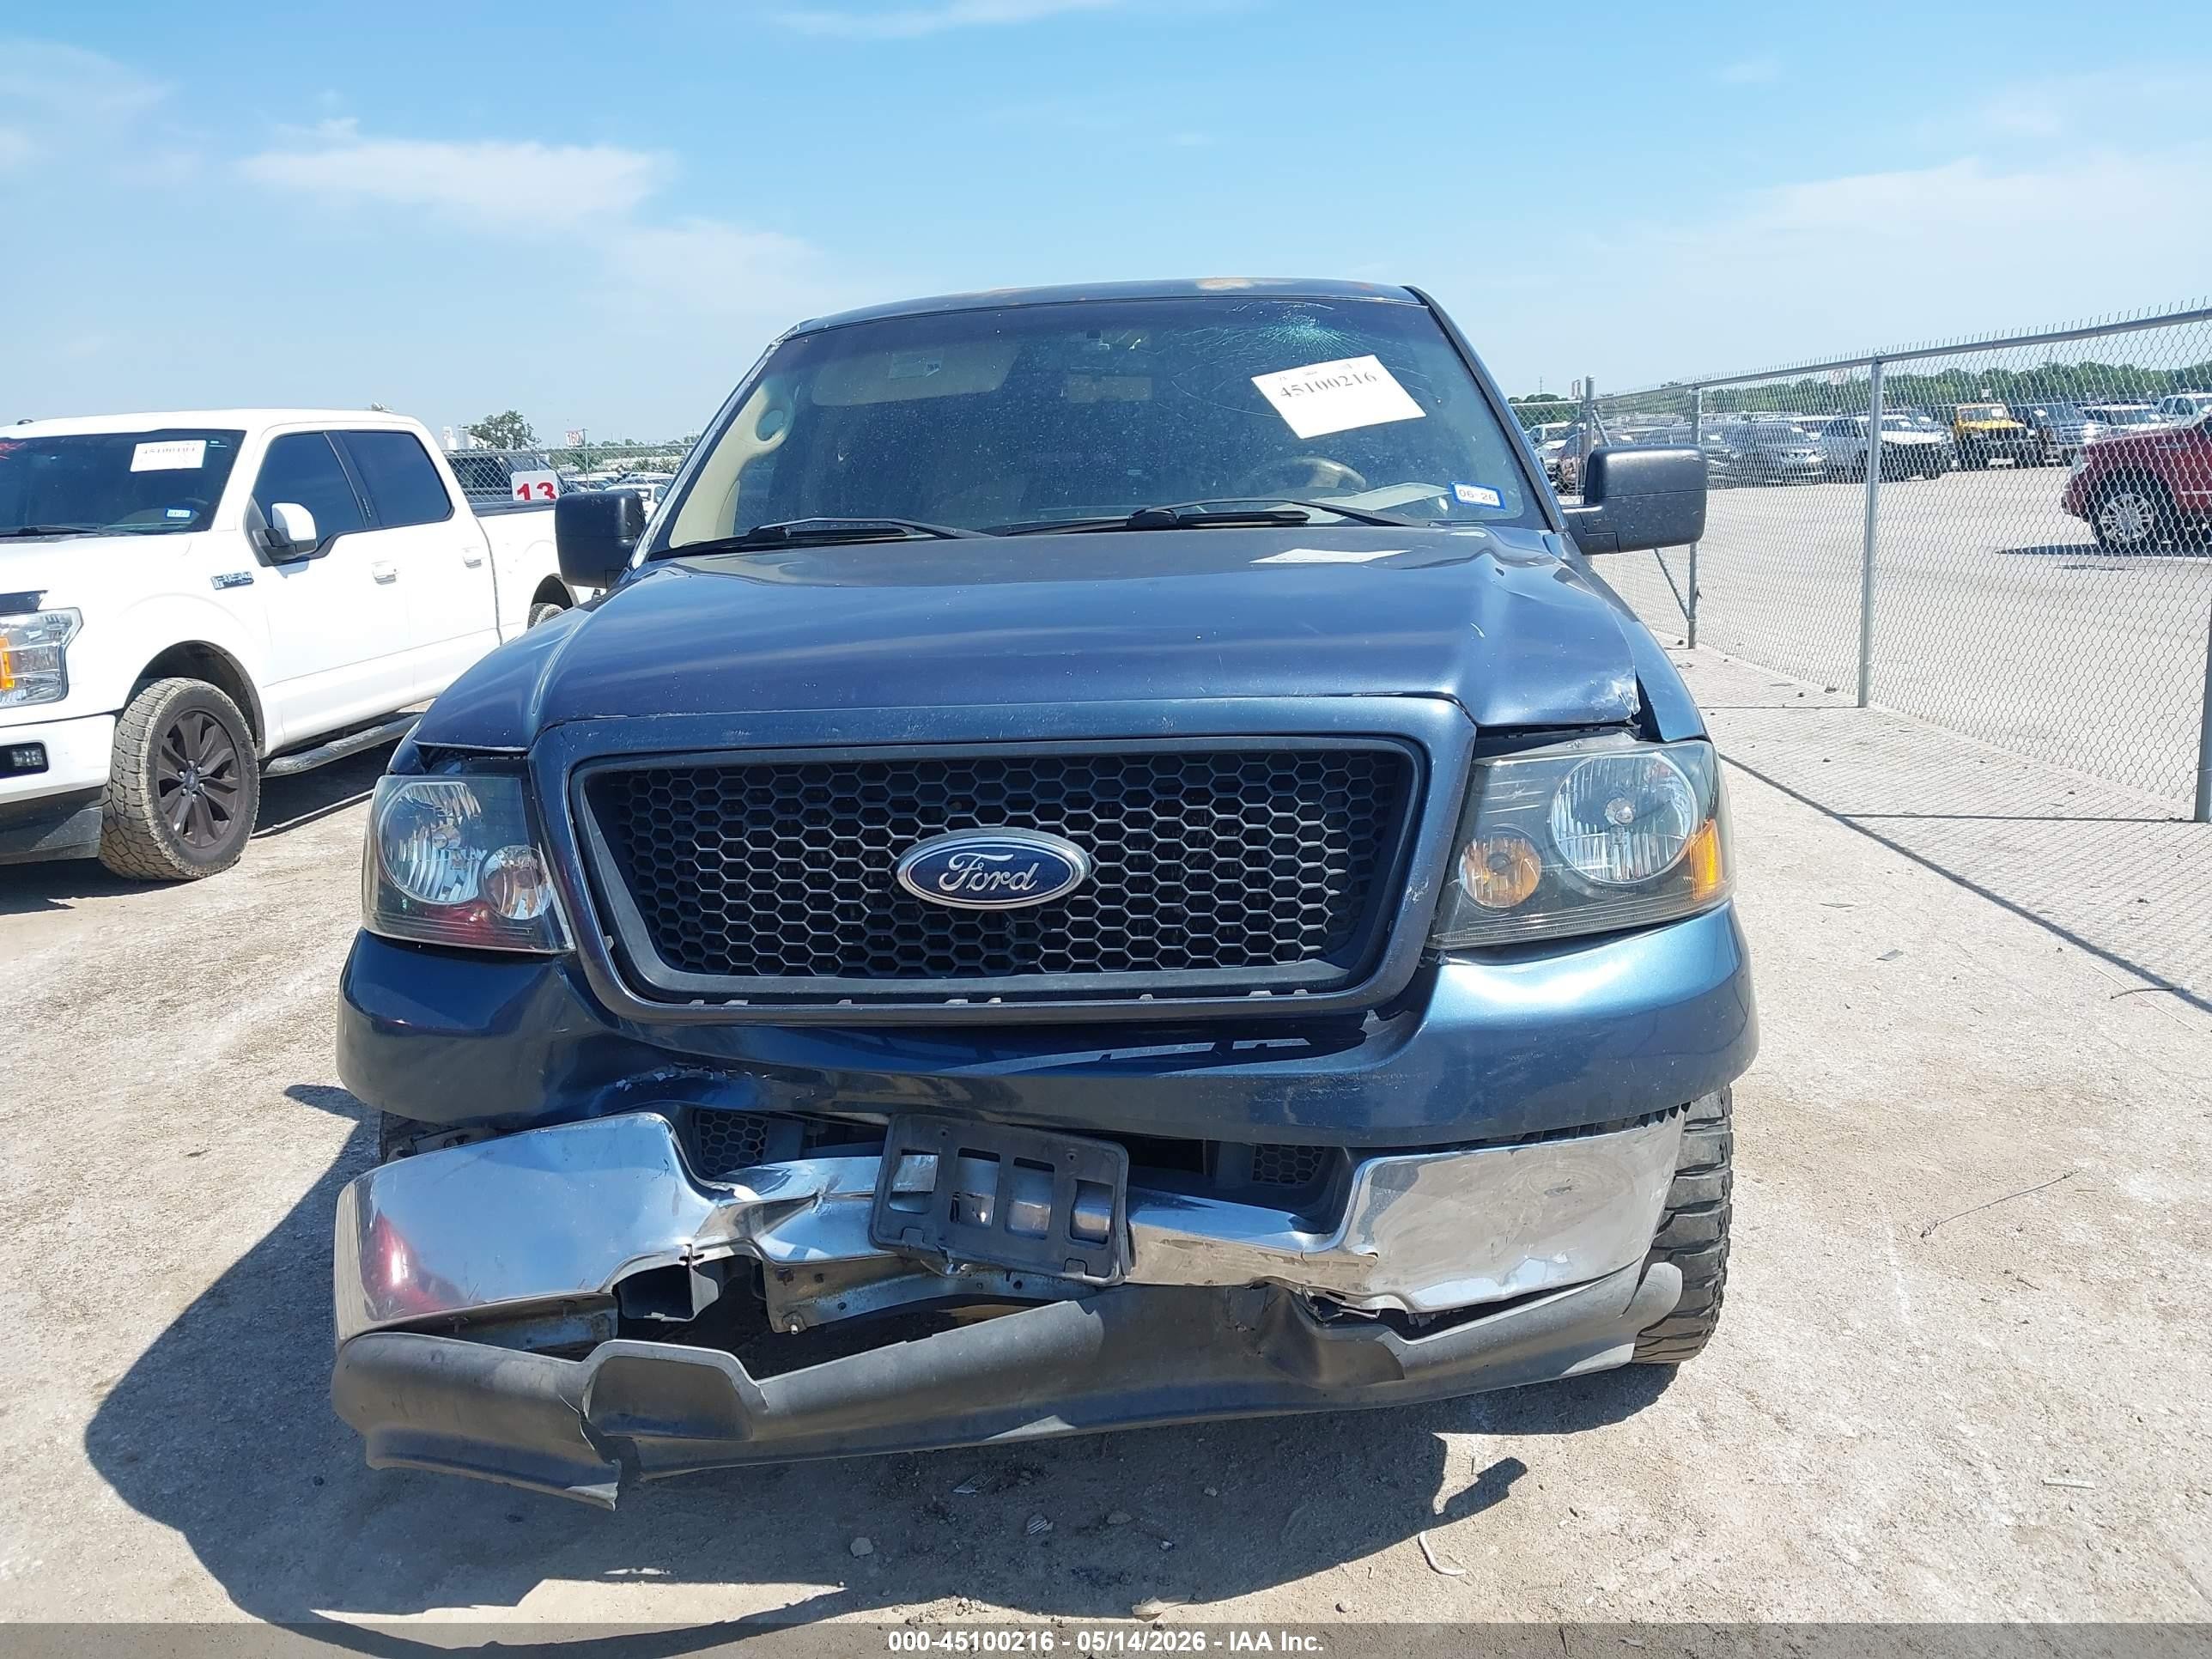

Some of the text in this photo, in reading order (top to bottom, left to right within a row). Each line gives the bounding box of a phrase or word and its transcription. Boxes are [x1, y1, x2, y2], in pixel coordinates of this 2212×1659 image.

[1280, 371, 1377, 398] 45100216
[568, 432, 580, 443] 160
[939, 853, 1039, 891] Ford
